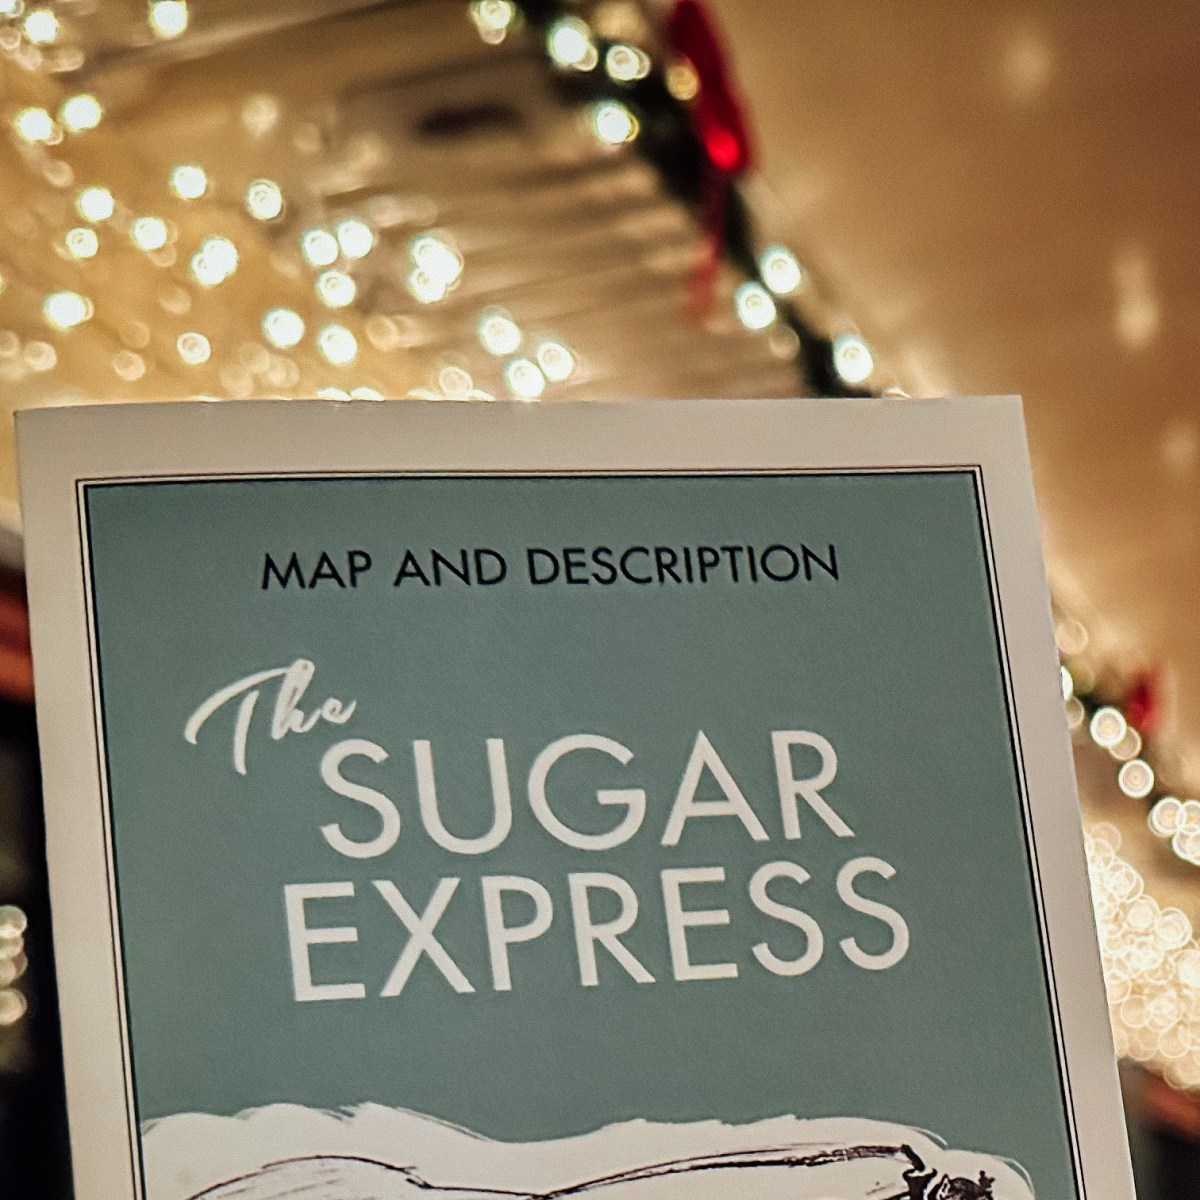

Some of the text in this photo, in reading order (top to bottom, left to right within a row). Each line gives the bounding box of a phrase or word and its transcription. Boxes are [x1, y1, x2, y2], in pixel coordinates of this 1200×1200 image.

[262, 543, 839, 590] MAP AND DESCRIPTION
[184, 658, 357, 776] The
[320, 730, 855, 859] SUGAR
[283, 856, 911, 1002] EXPRESS
